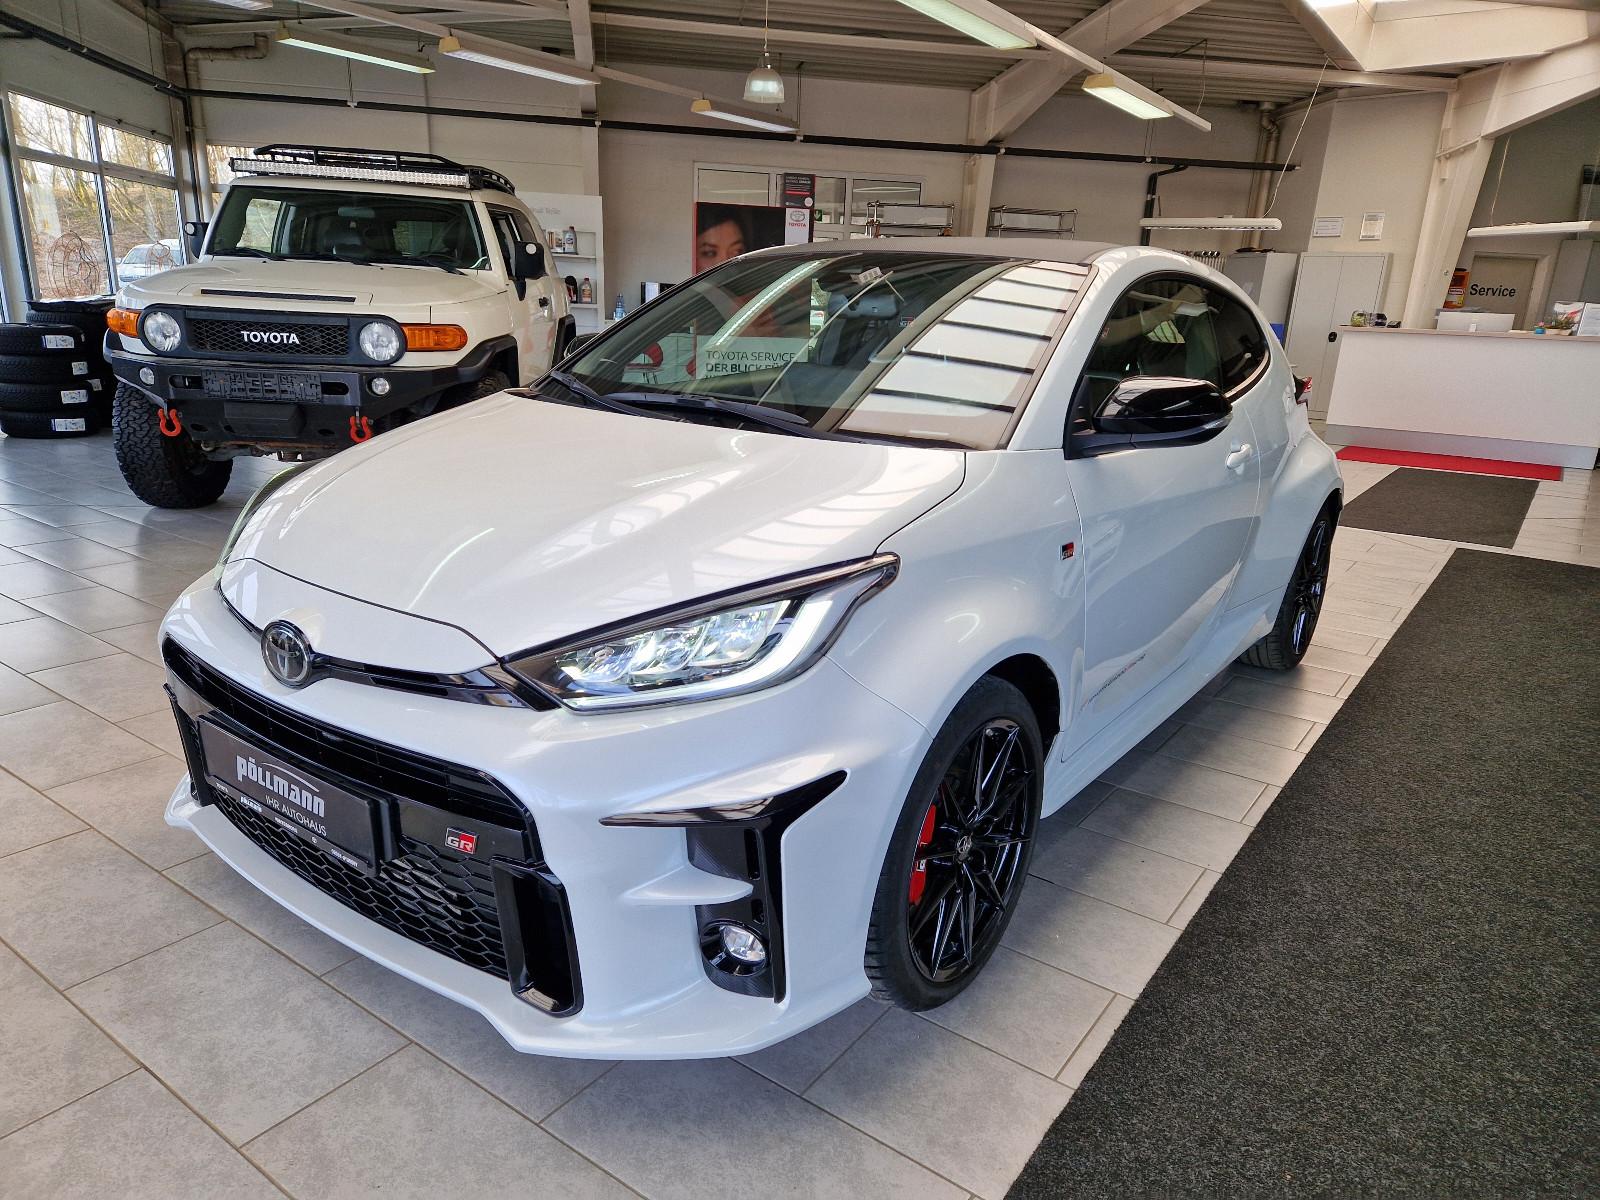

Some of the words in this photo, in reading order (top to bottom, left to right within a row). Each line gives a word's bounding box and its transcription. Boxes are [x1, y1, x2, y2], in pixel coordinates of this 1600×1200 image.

[1469, 283, 1516, 298] Service
[240, 330, 300, 345] TOYOTA
[705, 350, 749, 361] TOYOTA
[705, 362, 729, 373] DER
[265, 794, 281, 811] IHR
[281, 803, 328, 837] AUTOHAUS
[446, 835, 474, 852] GR
